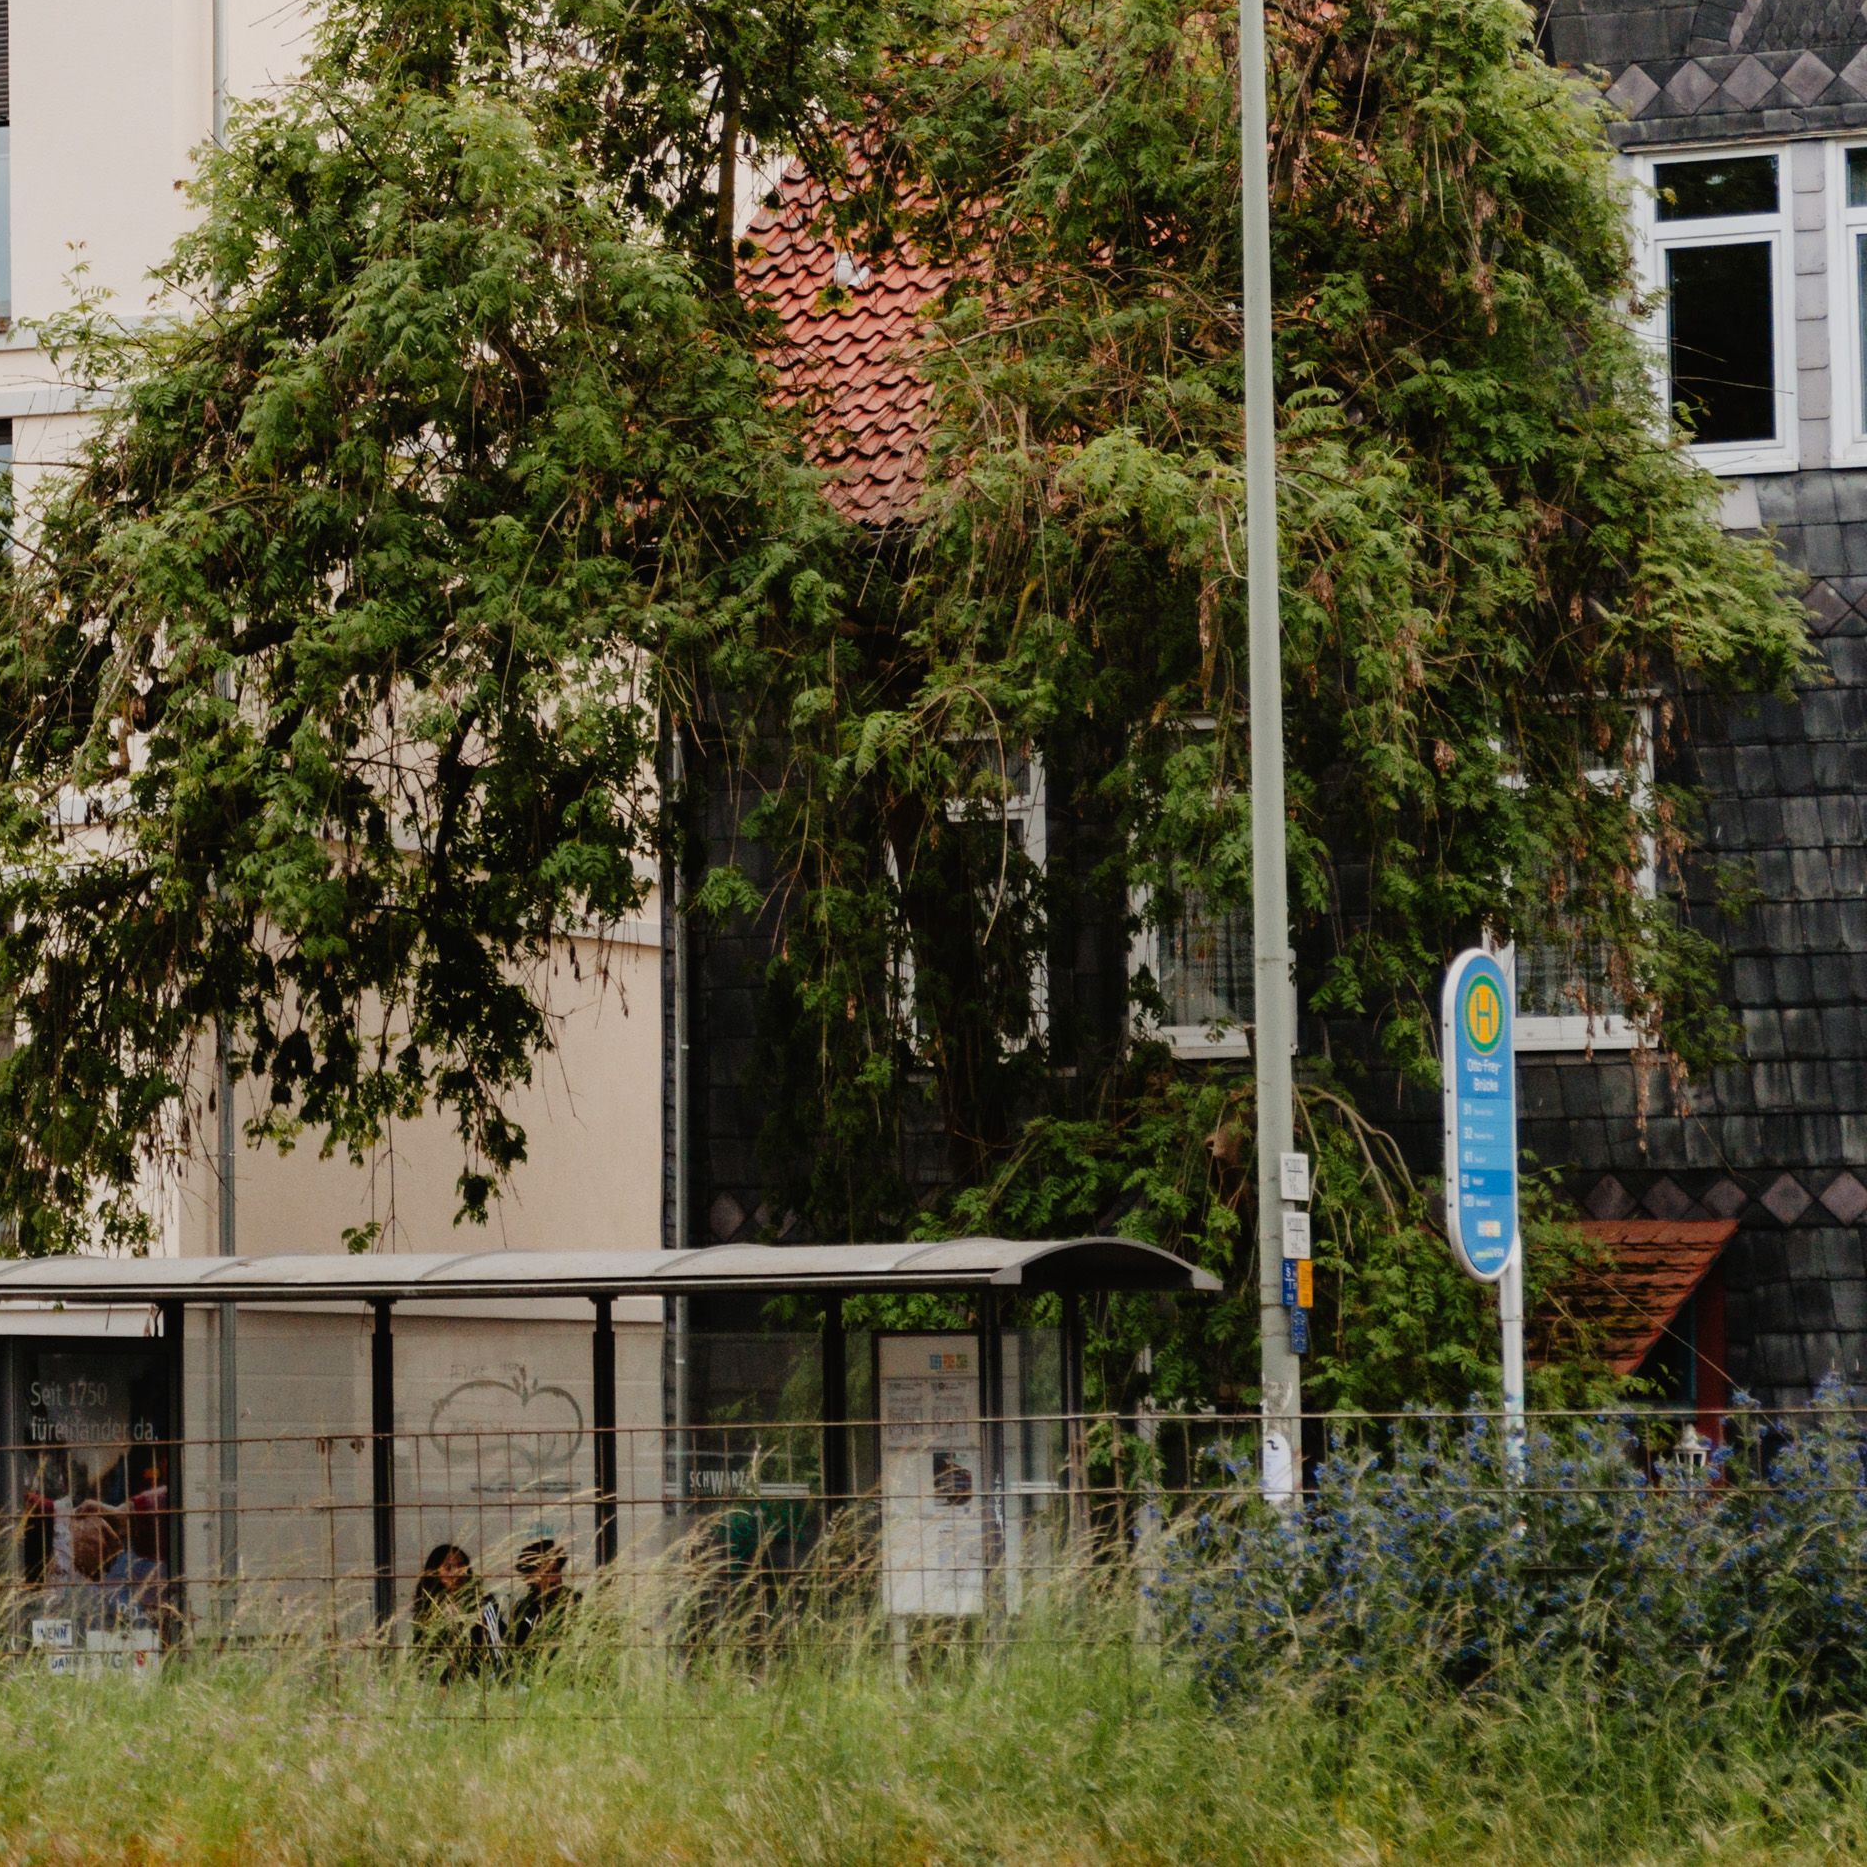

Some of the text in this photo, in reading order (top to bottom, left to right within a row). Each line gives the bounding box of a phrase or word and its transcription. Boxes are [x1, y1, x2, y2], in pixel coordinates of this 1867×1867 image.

[1475, 992, 1493, 1037] H
[30, 1381, 108, 1406] Seit 1750
[31, 1415, 159, 1442] füreinander da.
